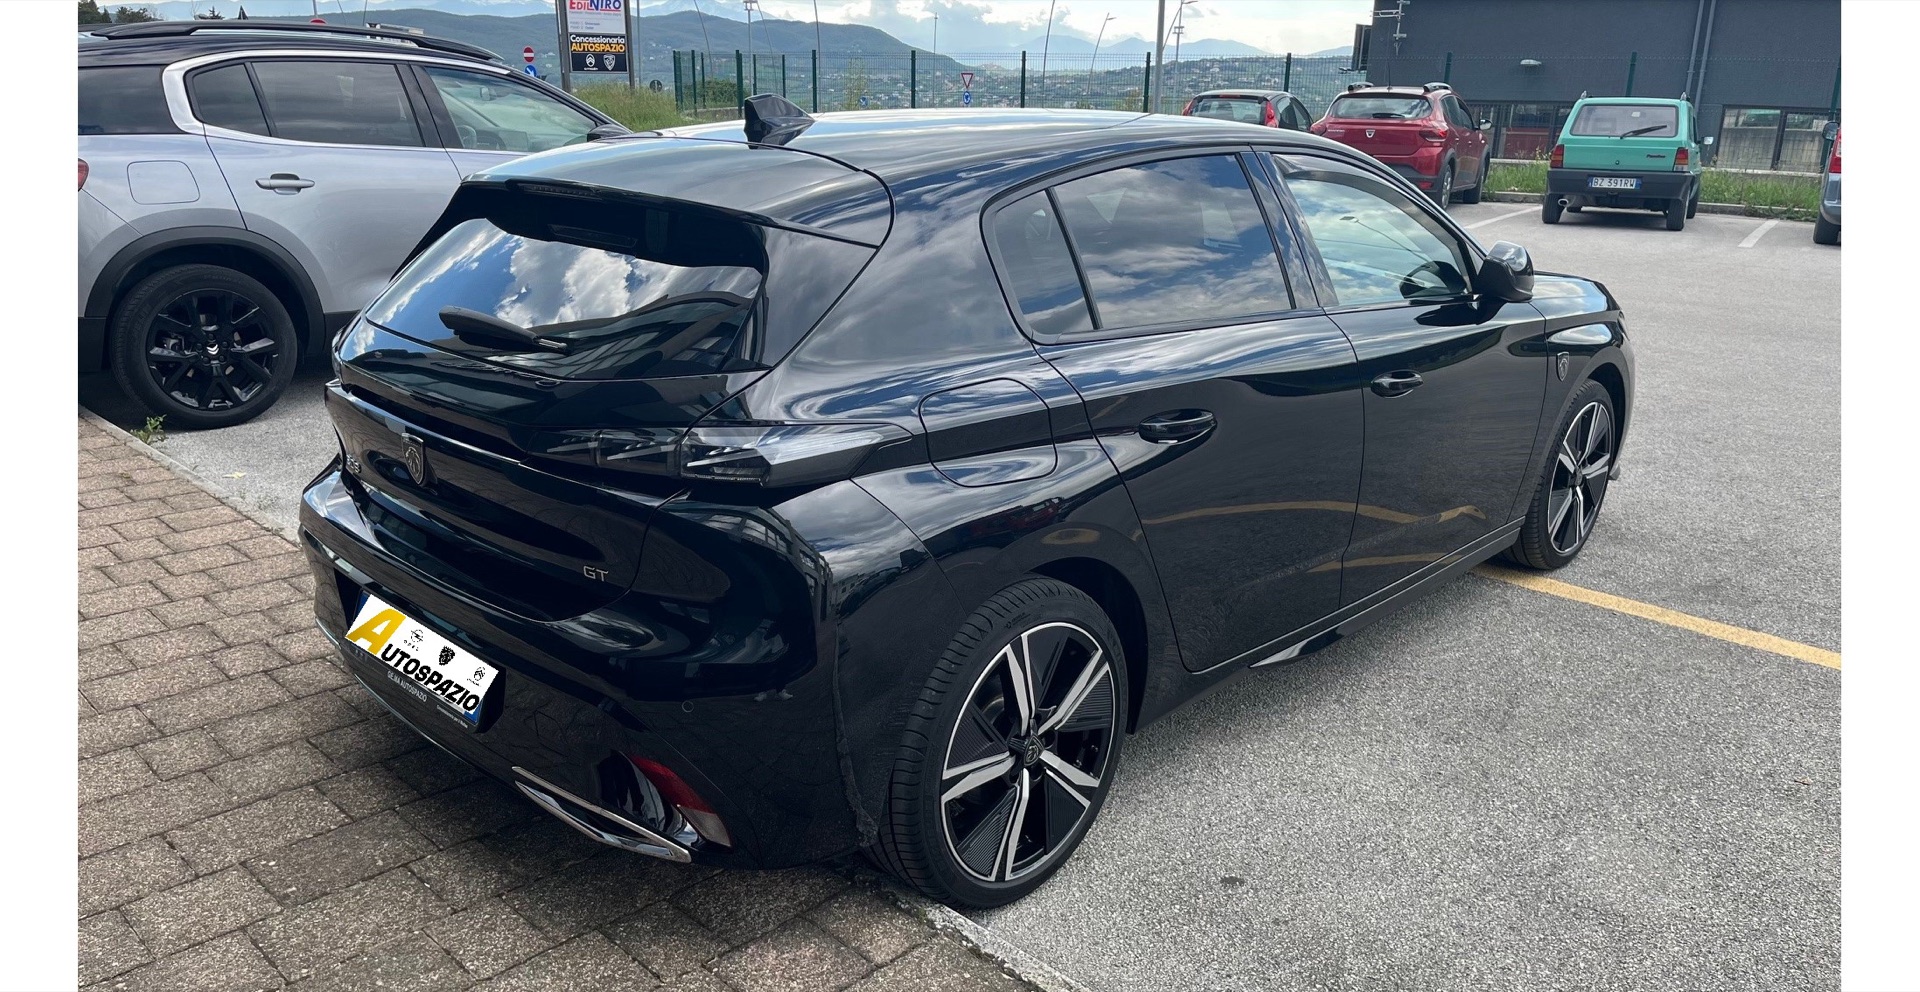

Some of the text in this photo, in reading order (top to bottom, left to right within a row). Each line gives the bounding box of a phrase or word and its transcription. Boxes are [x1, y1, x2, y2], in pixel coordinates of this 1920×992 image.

[570, 35, 625, 43] Concessionaria
[571, 43, 625, 52] AUTOSPAZIO
[1593, 177, 1604, 187] BZ
[583, 565, 609, 581] GT
